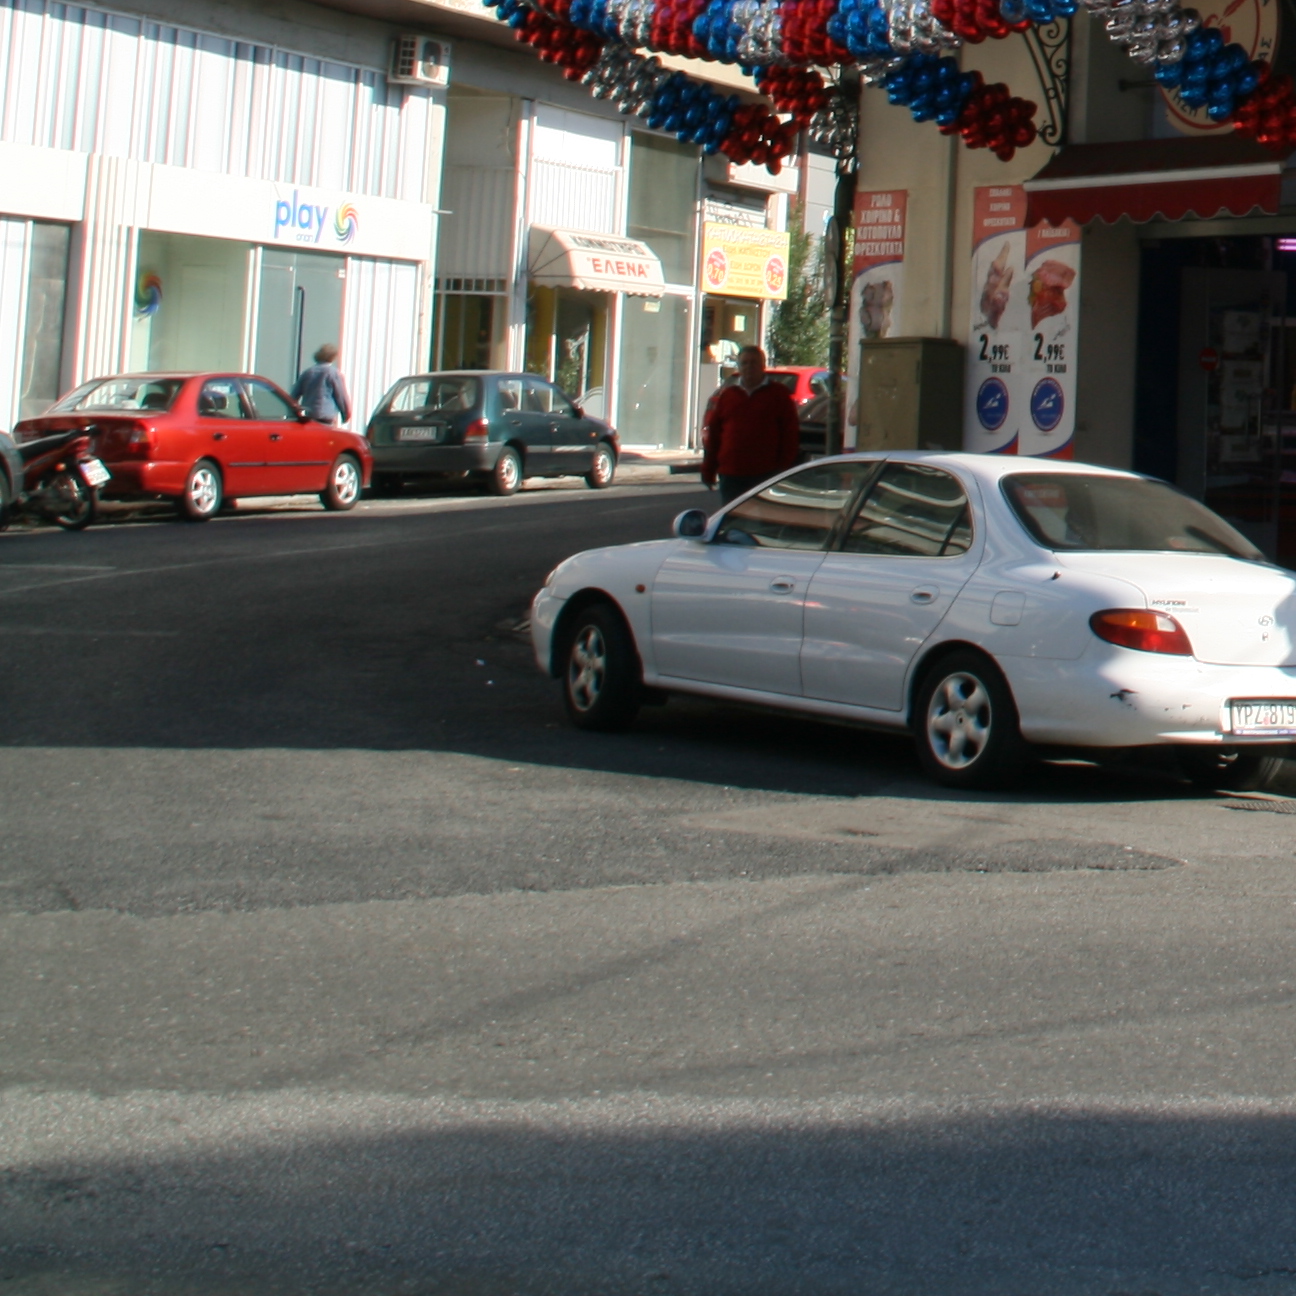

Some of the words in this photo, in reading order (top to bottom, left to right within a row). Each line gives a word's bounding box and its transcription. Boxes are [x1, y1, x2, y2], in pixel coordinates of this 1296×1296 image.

[274, 189, 329, 243] play
[855, 241, 904, 255] ΦΡΕΣΚΟΤΑΤΑ
[586, 257, 650, 279] "ΕΛΕΝΑ"
[979, 334, 1010, 363] 2,99€
[1034, 333, 1066, 364] 2,99€
